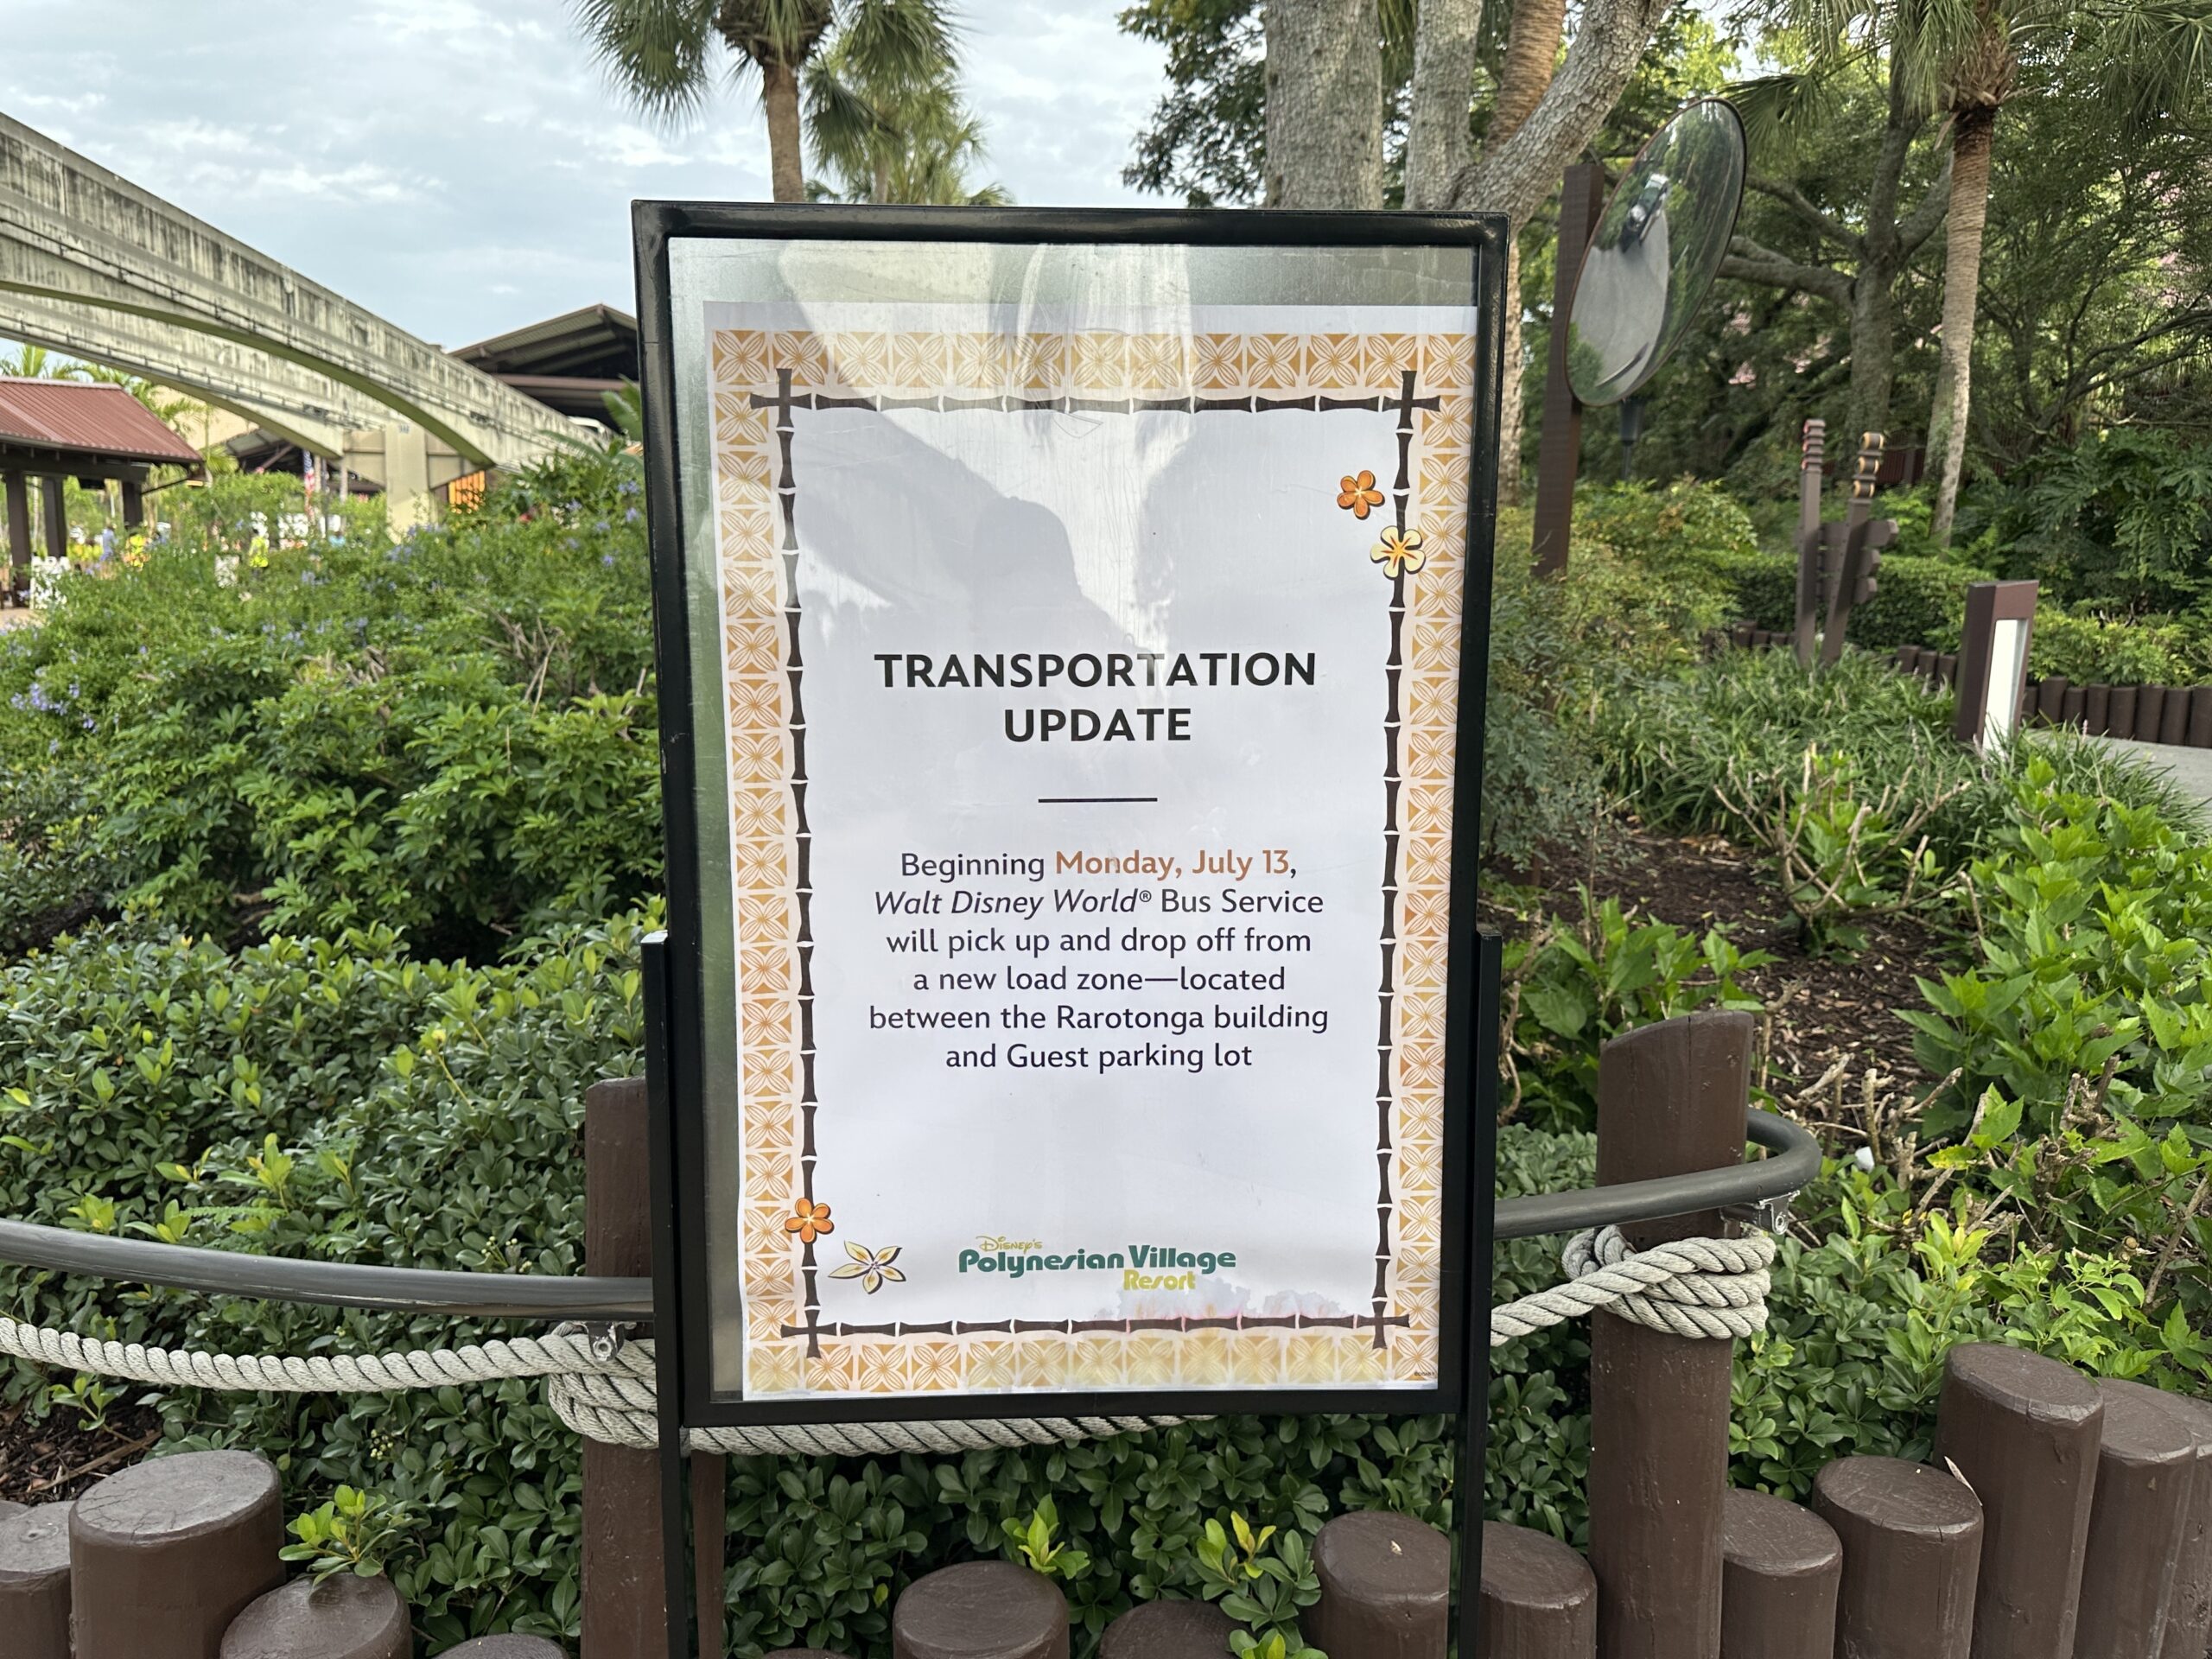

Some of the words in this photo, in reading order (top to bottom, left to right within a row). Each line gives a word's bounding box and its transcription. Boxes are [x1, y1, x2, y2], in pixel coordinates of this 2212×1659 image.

[874, 652, 1315, 688] TRANSPORTATION
[1005, 709, 1191, 742] UPDATE
[902, 853, 1044, 883] Beginning
[1057, 849, 1181, 881] Monday,
[1192, 849, 1253, 881] July
[1262, 850, 1296, 879] 13,
[875, 890, 943, 915] Walt
[951, 891, 1044, 920] Disney
[1162, 889, 1211, 912] Bus
[1222, 888, 1323, 912] Service
[886, 928, 938, 952] will
[949, 927, 1006, 959] pick
[1016, 935, 1050, 958] up
[1060, 927, 1109, 950] and
[1122, 927, 1185, 958] drop
[1197, 927, 1236, 951] off
[1244, 927, 1310, 951] from
[913, 974, 929, 990] a
[940, 973, 996, 989] new
[1007, 965, 1066, 989] load
[870, 1006, 989, 1028] between
[1001, 1004, 1046, 1029] the
[1058, 1005, 1205, 1035] Rarotonga
[1215, 1004, 1327, 1033] building
[946, 1043, 995, 1067] and
[1007, 1044, 1089, 1068] Guest
[1099, 1042, 1203, 1074] parking
[1215, 1042, 1252, 1066] lot
[958, 1249, 1124, 1278] Polynesian
[1128, 1244, 1236, 1274] Village
[1123, 1269, 1196, 1290] Resort
